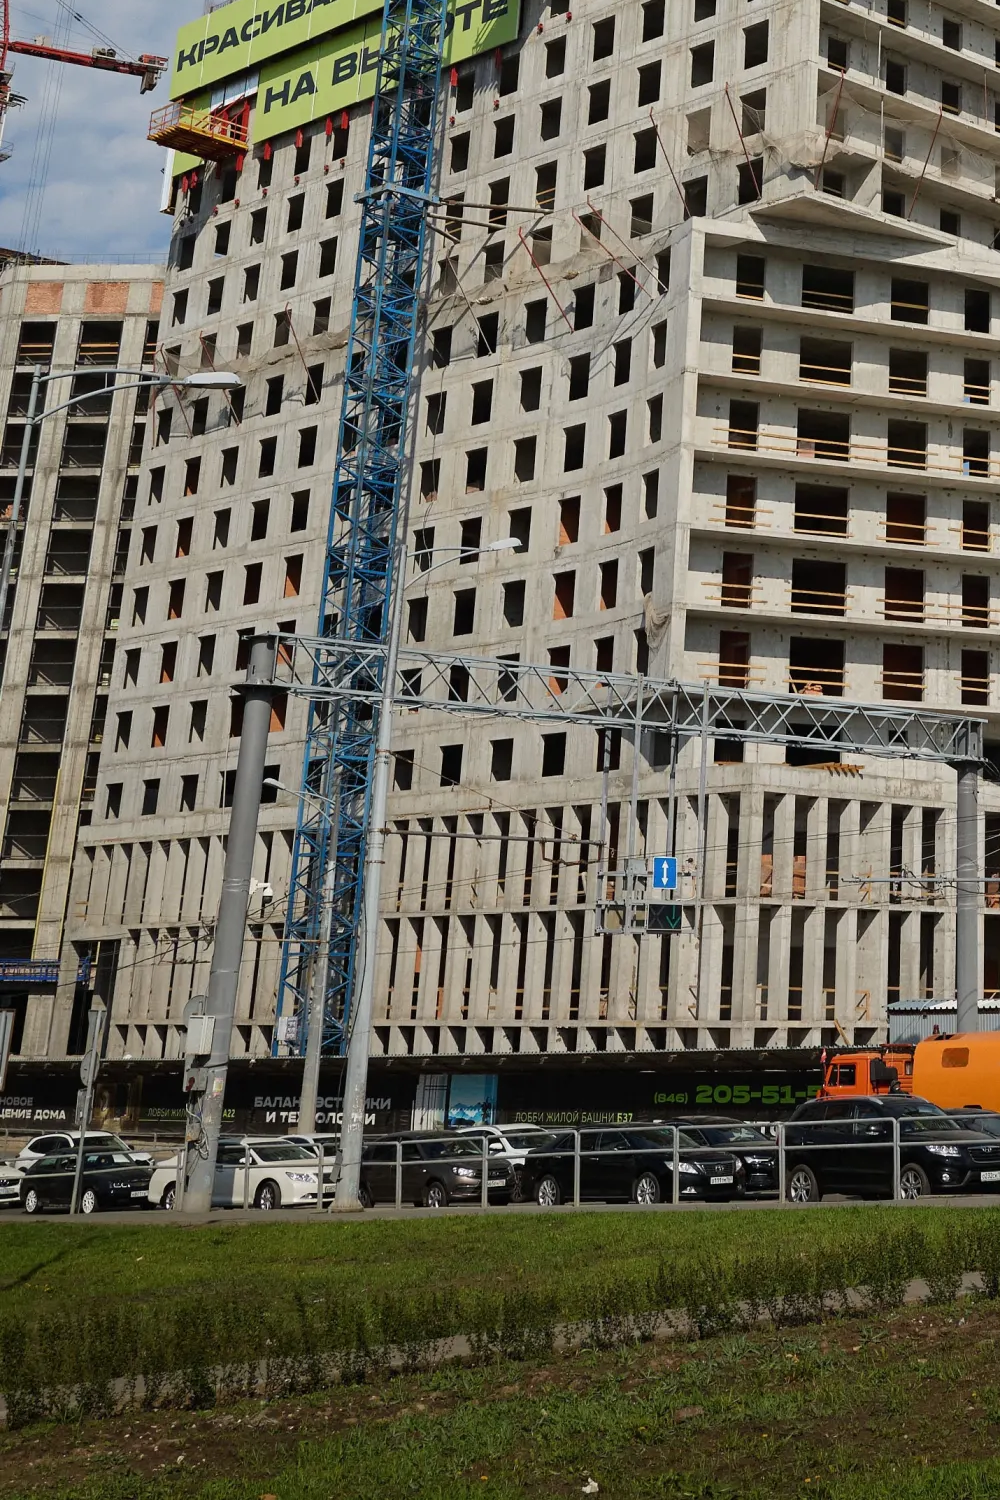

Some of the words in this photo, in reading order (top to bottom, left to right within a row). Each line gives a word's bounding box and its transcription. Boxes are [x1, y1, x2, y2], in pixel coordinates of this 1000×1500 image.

[263, 74, 318, 113] НА
[695, 1085, 822, 1104] 205-51-5
[254, 1096, 302, 1108] БАЛАН
[33, 1109, 66, 1121] ДОМА
[265, 1111, 277, 1123] И
